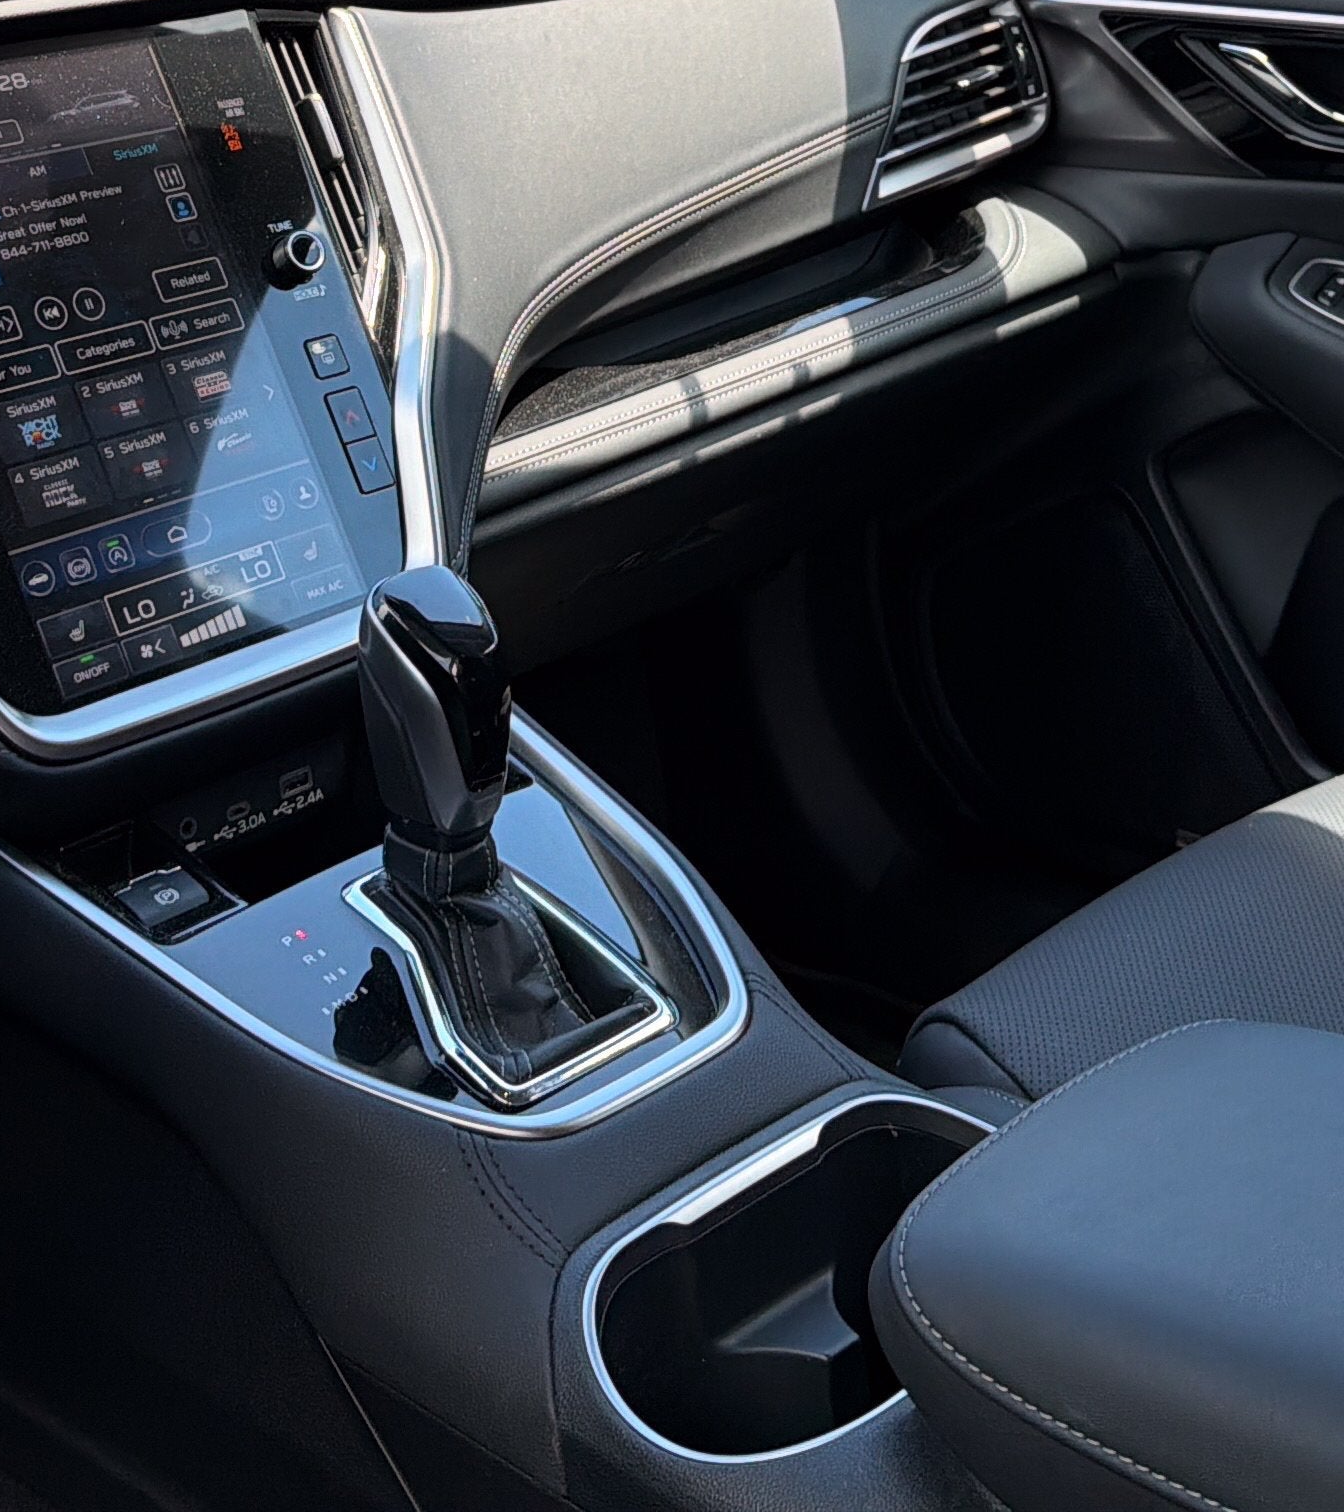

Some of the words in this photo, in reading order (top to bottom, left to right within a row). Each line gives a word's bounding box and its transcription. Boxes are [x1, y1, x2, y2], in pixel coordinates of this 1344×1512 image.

[29, 165, 48, 178] AM
[112, 143, 159, 162] SiriusXM
[81, 184, 123, 202] Preview
[29, 220, 57, 236] Offer
[60, 213, 88, 229] Now!
[267, 219, 294, 234] TUNE
[0, 231, 90, 261] 844-711-8800
[170, 269, 211, 289] Related
[193, 311, 231, 331] Search
[76, 336, 136, 361] Categories
[9, 362, 32, 378] You
[166, 362, 177, 376] 3
[180, 350, 227, 372] SiriusXM
[81, 386, 92, 399] 2
[95, 371, 144, 395] SiriusXM
[6, 394, 57, 419] SiriusXM
[188, 421, 200, 434] 6
[203, 407, 249, 430] SiriusXM
[104, 446, 115, 459] 5
[118, 431, 167, 455] SiriusXM
[30, 456, 80, 481] SiriusXM
[240, 559, 272, 584] LO
[122, 598, 157, 625] LO
[73, 662, 111, 684] ON/OFF
[237, 811, 267, 834] 3.0A
[296, 787, 325, 809] 2.4A
[280, 935, 293, 947] P
[302, 953, 317, 966] R
[322, 971, 339, 985] N
